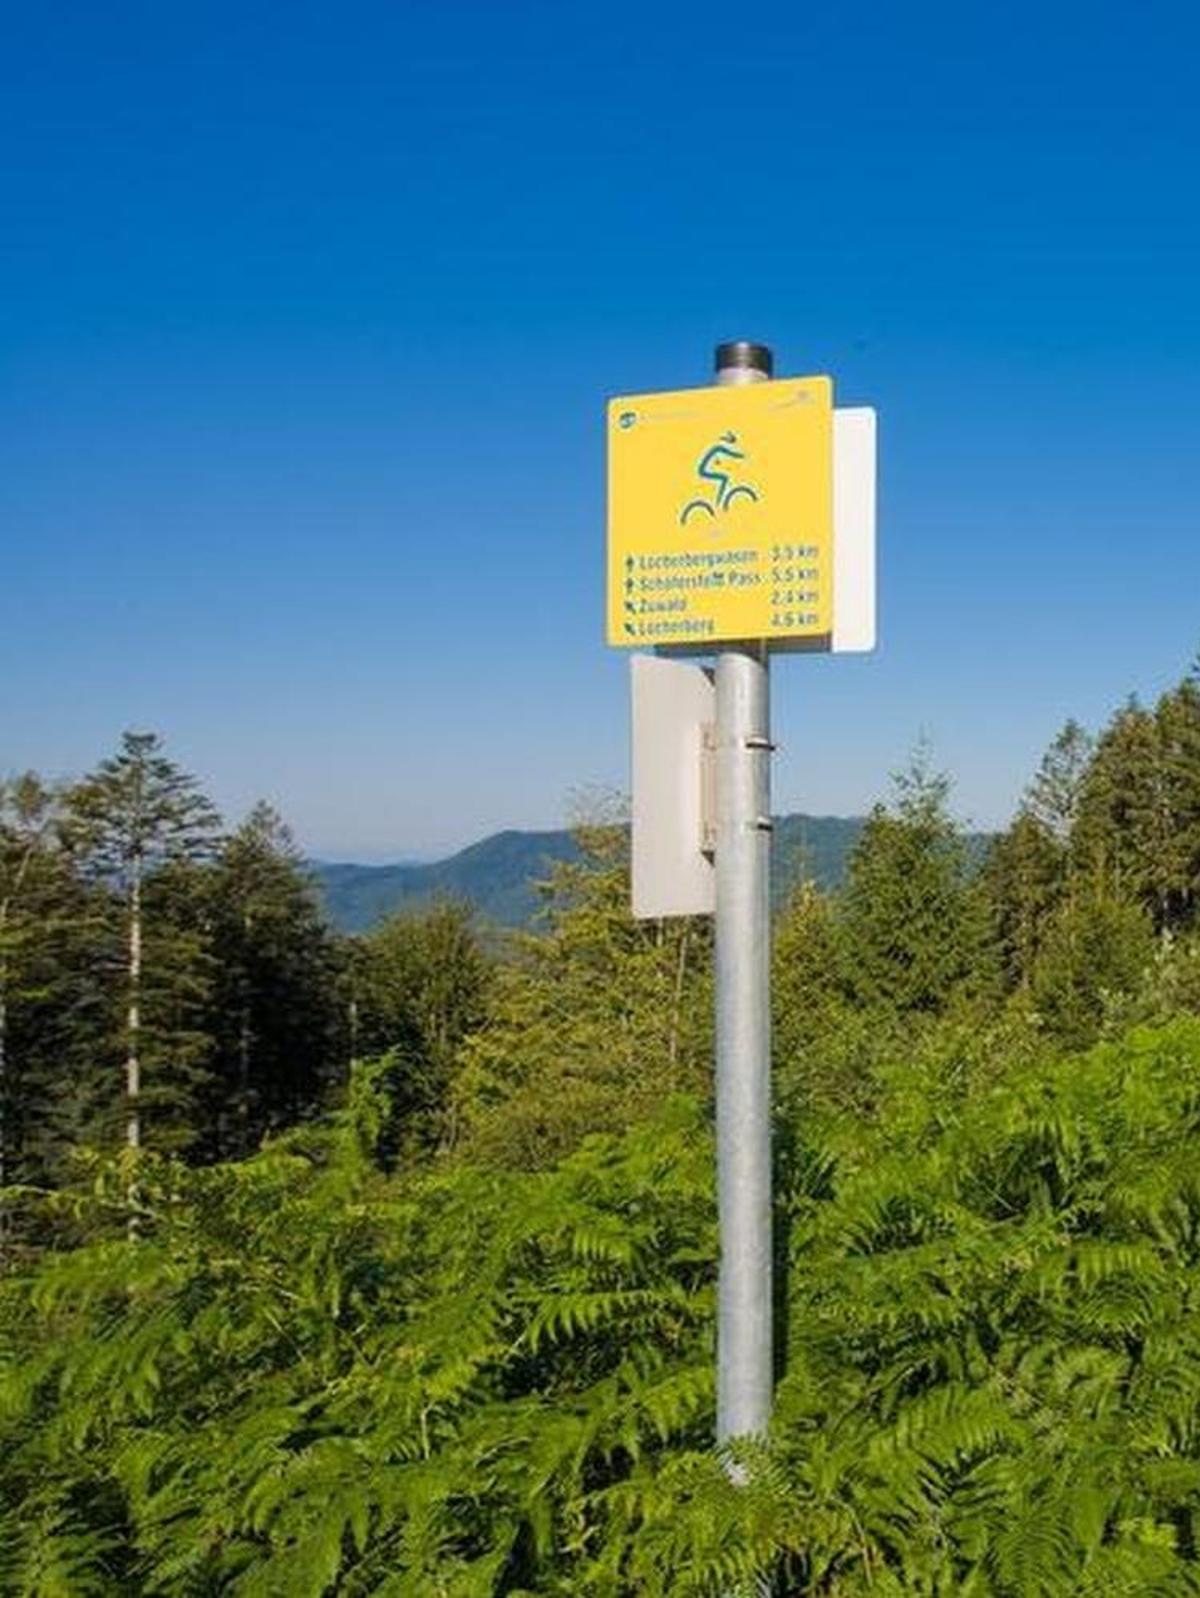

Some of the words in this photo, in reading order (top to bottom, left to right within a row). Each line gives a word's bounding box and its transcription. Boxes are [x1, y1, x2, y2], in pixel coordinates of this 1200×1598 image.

[797, 544, 820, 559] km
[728, 570, 762, 586] Pass
[797, 566, 820, 581] km
[638, 598, 688, 615] Zuwald
[797, 589, 820, 603] km
[797, 611, 820, 626] km
